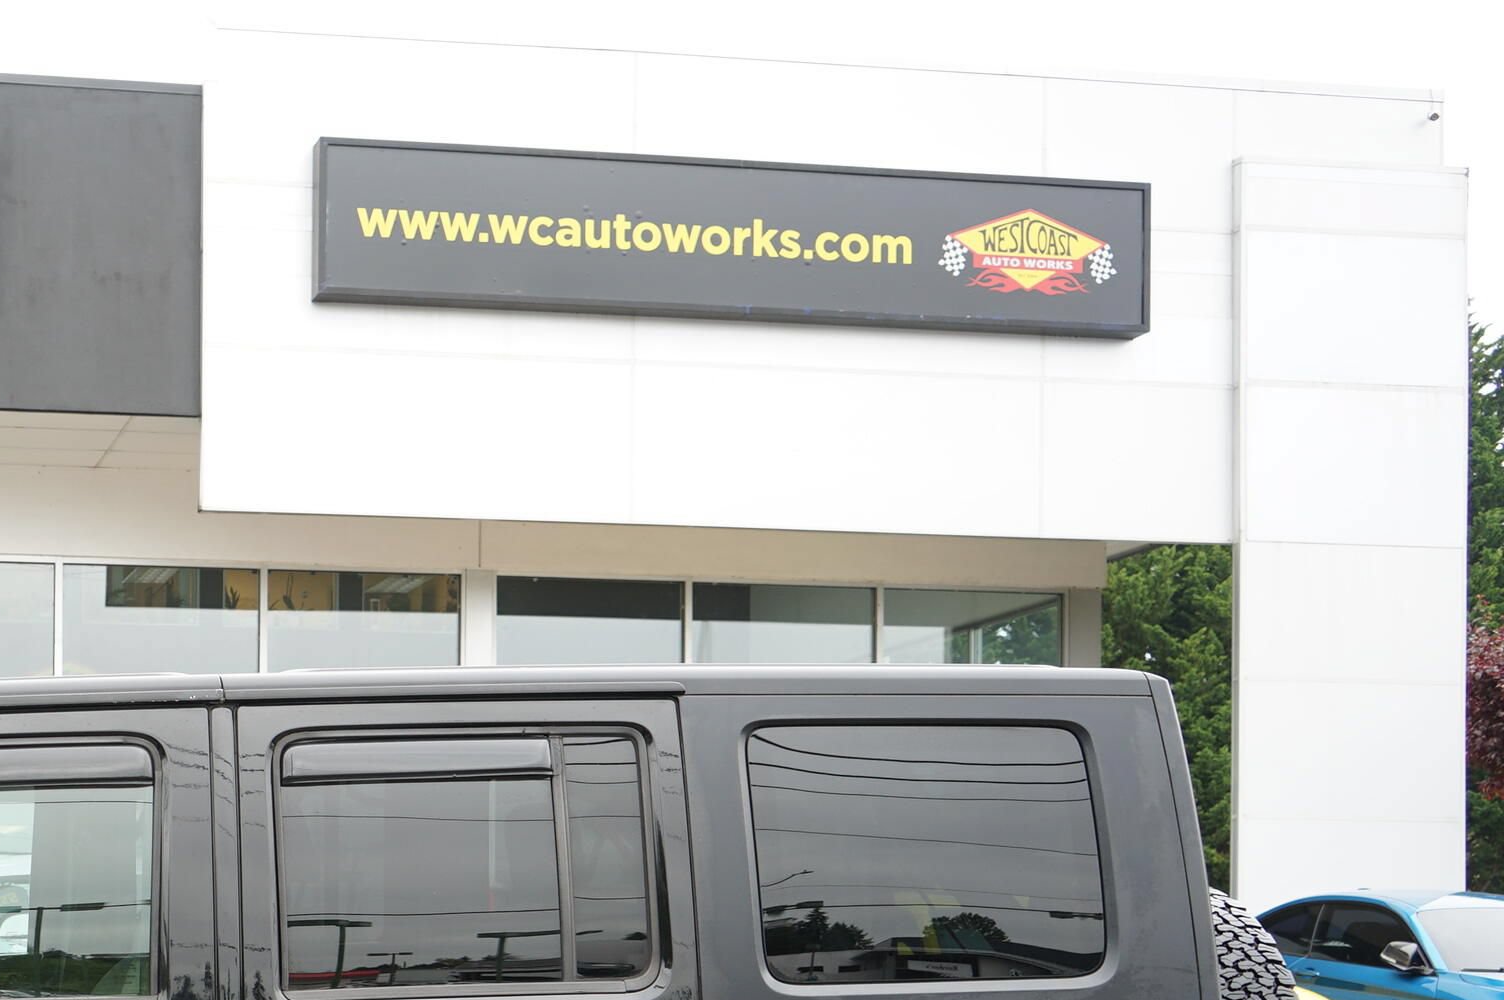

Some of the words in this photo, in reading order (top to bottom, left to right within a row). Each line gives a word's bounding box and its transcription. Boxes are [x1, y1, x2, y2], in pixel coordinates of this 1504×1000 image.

[357, 208, 913, 264] www.wcautoworks.com
[979, 217, 1079, 257] WESTCOAST
[982, 256, 1020, 267] AUTO
[1023, 258, 1073, 271] WORKS
